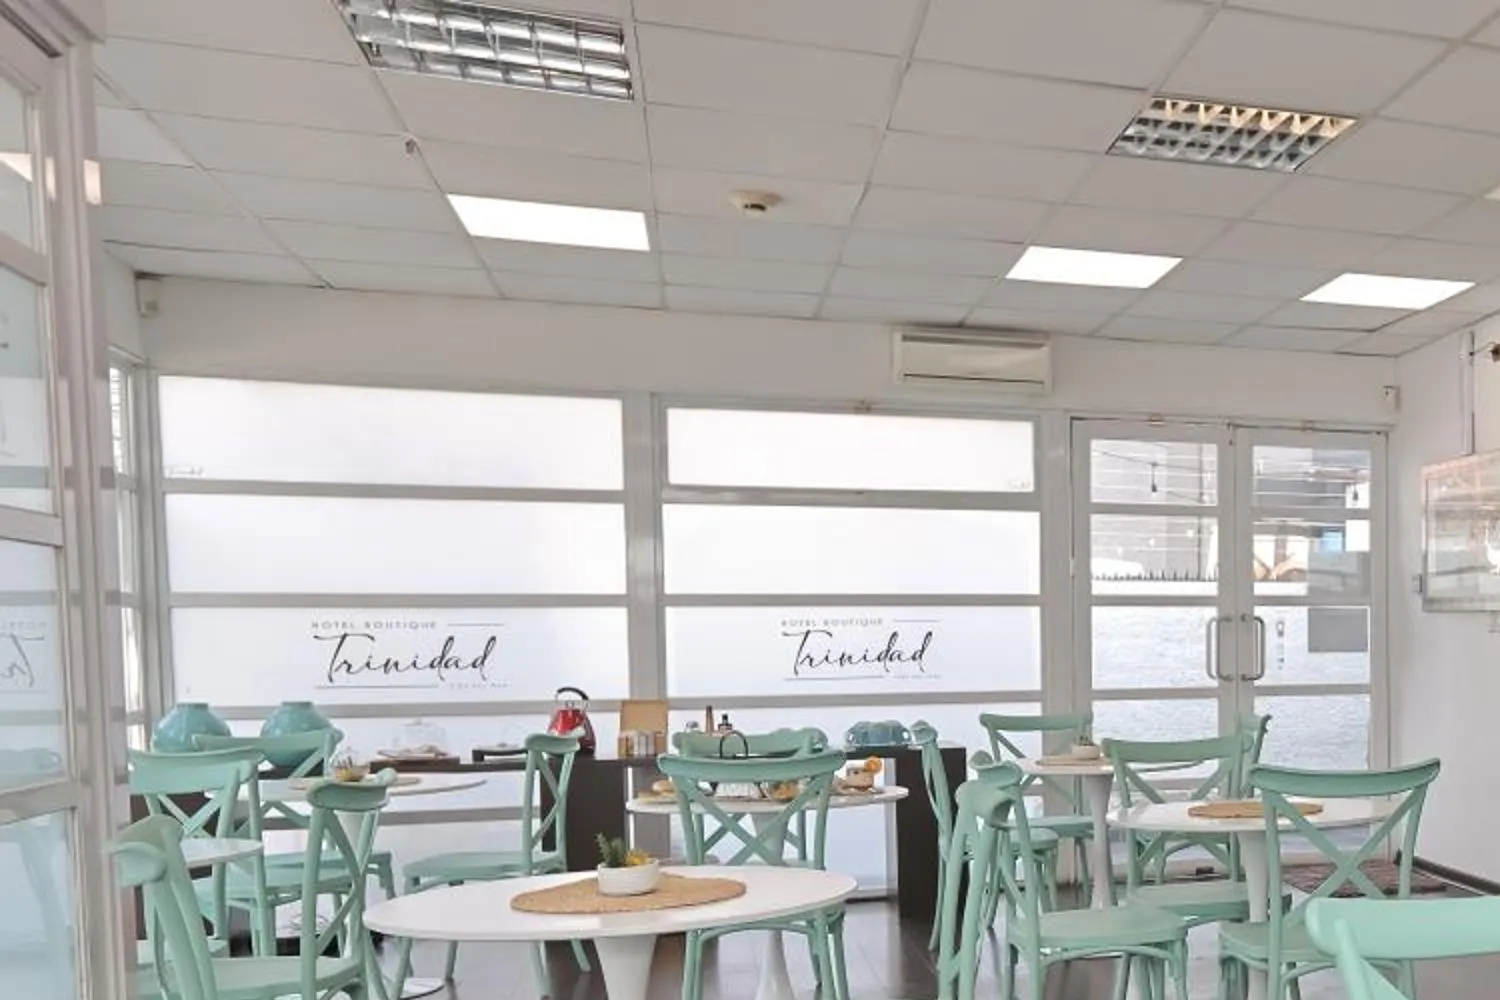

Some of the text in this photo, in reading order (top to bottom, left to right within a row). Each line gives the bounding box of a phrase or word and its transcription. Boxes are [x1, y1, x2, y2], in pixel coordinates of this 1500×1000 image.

[311, 620, 437, 631] HOTEL BOUTIQUE
[313, 632, 497, 683] Trinidad
[781, 629, 933, 676] Trinidad
